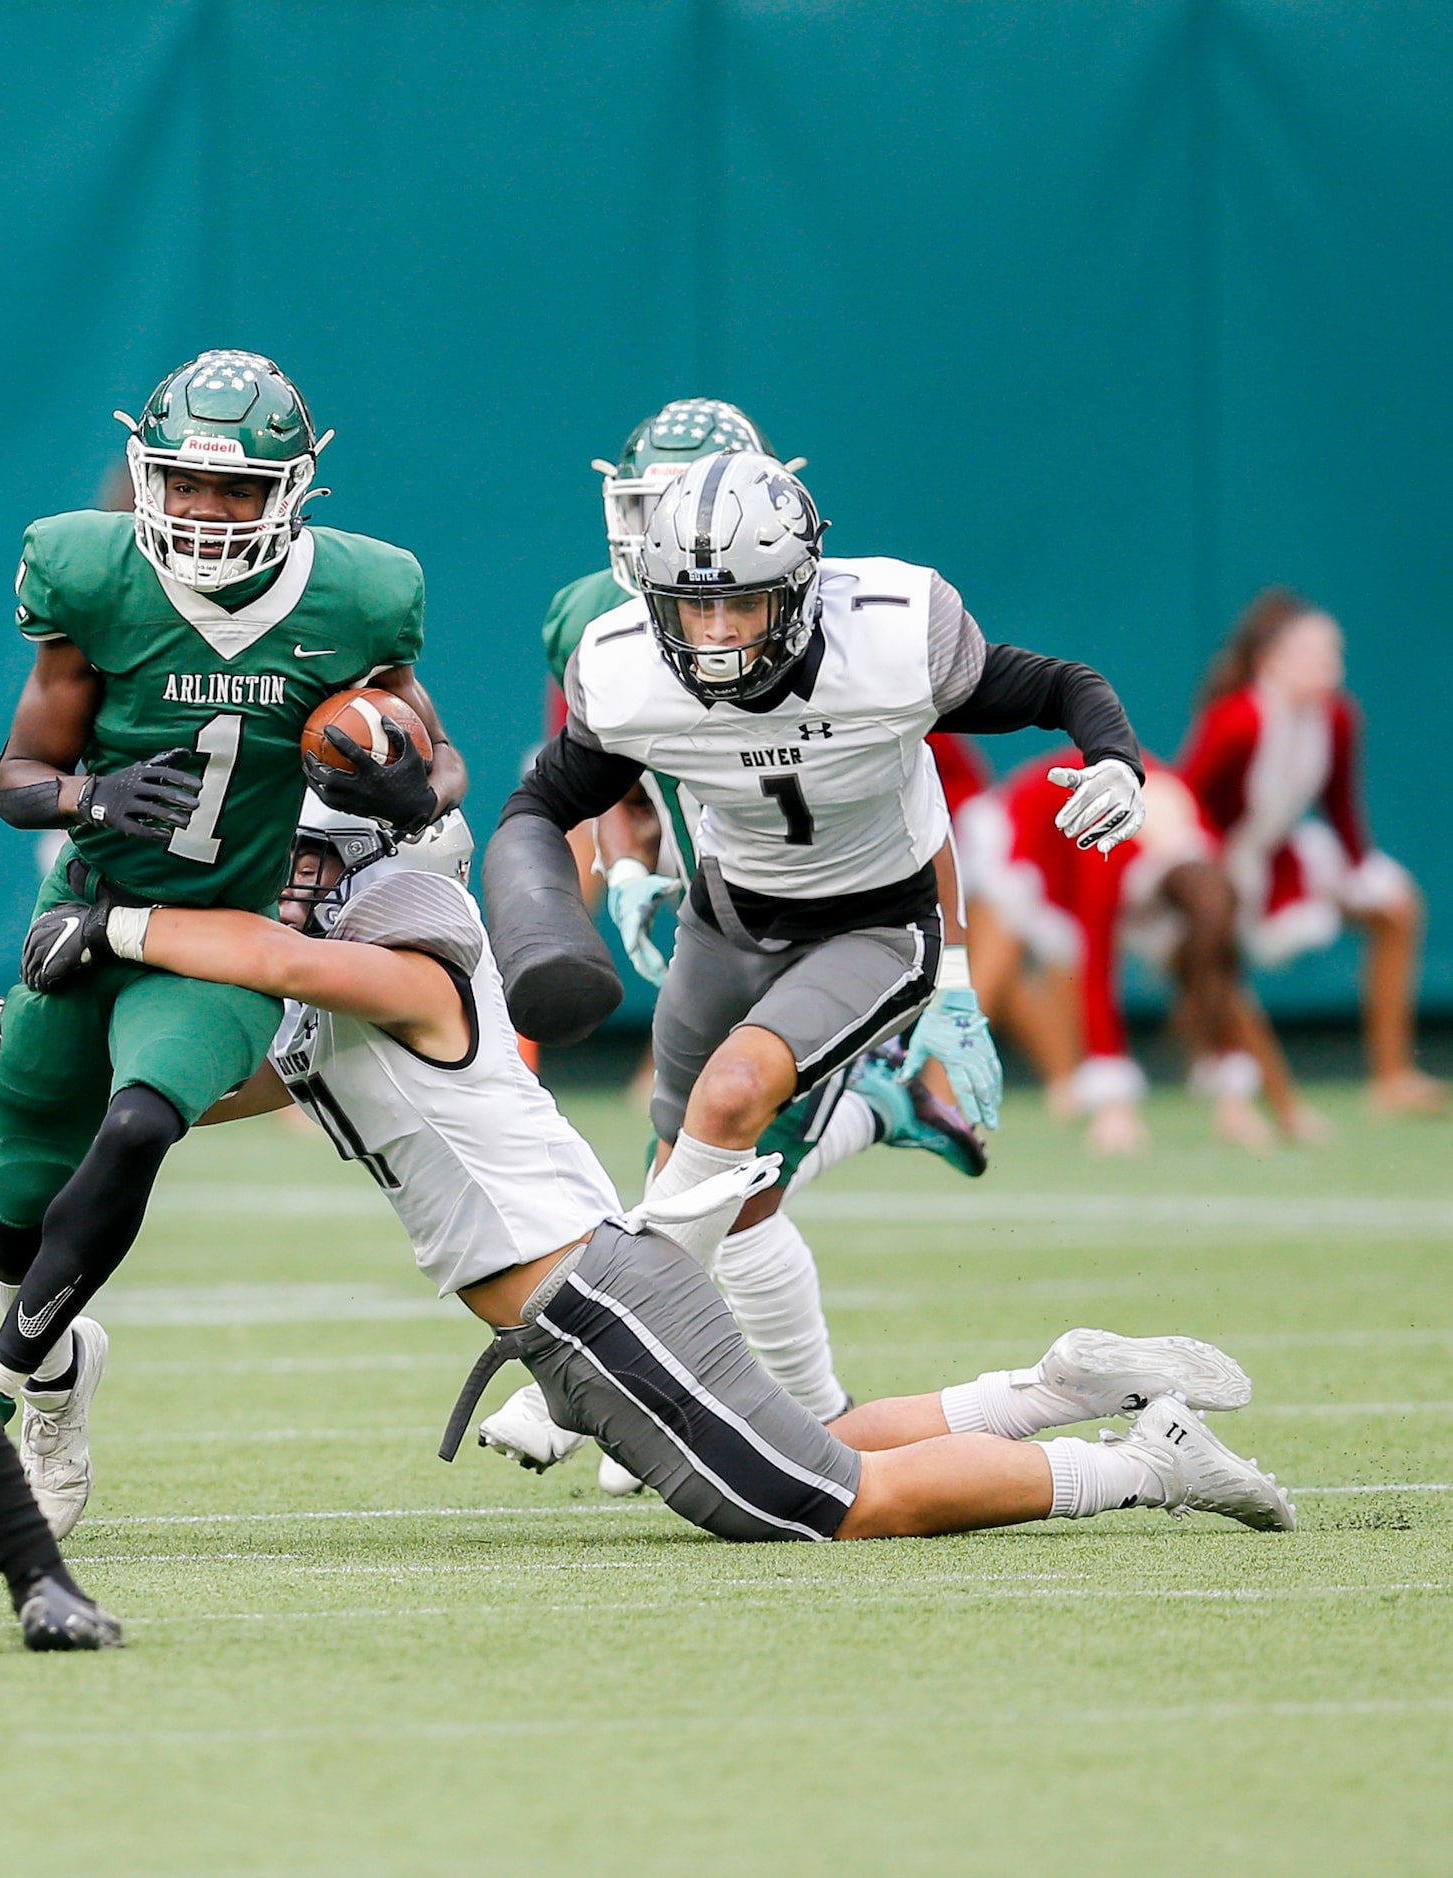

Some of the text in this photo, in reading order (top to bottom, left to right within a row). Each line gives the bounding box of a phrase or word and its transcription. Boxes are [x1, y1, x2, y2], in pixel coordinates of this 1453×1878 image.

[189, 439, 236, 453] Riddell
[162, 673, 286, 705] ARLINGTON
[740, 747, 802, 767] GUYER
[166, 713, 243, 866] 1
[759, 772, 814, 846] 1
[1165, 1422, 1188, 1446] 11
